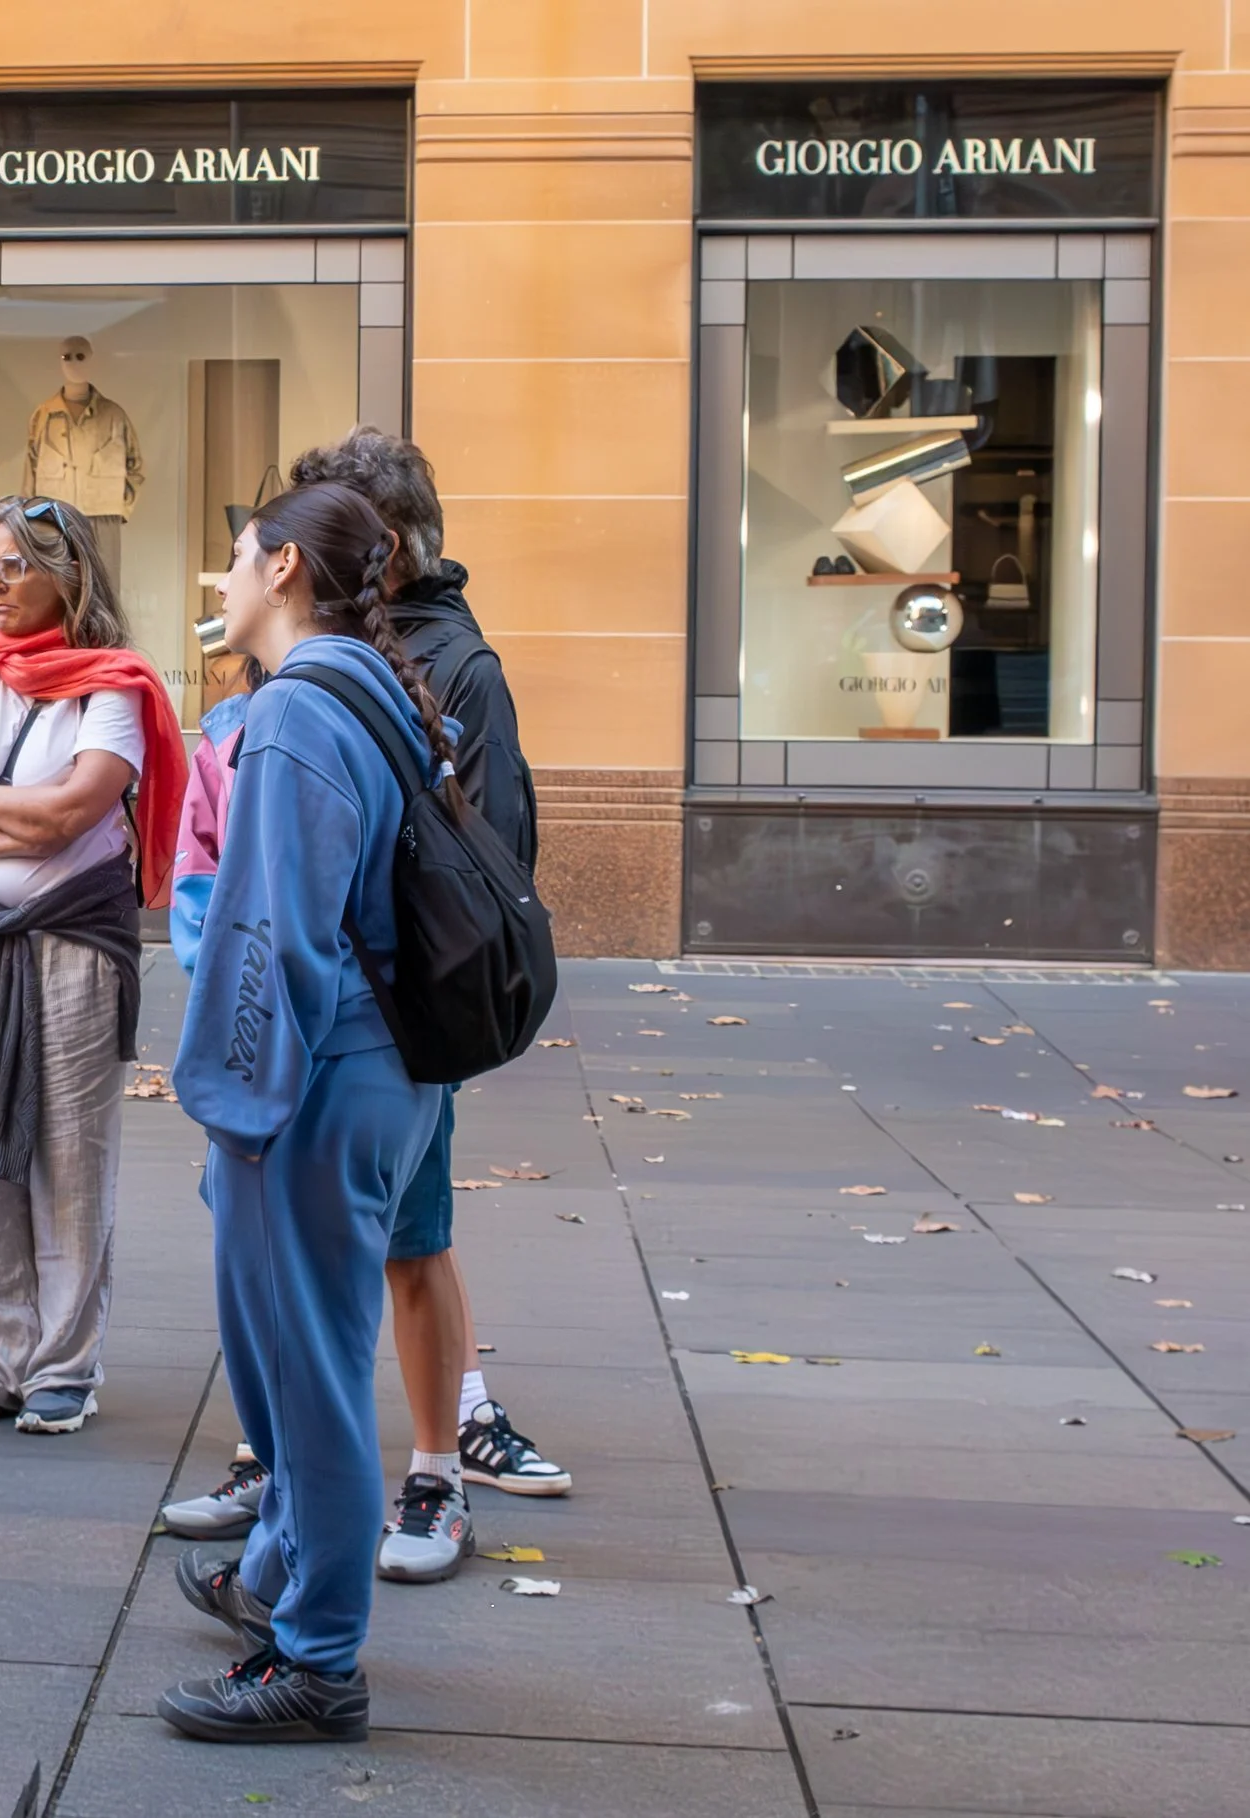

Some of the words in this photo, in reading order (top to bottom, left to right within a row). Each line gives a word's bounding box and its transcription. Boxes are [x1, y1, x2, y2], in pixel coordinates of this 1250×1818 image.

[164, 146, 321, 183] ARMANI
[755, 138, 923, 175] GIORGIO
[932, 137, 1097, 174] ARMANI
